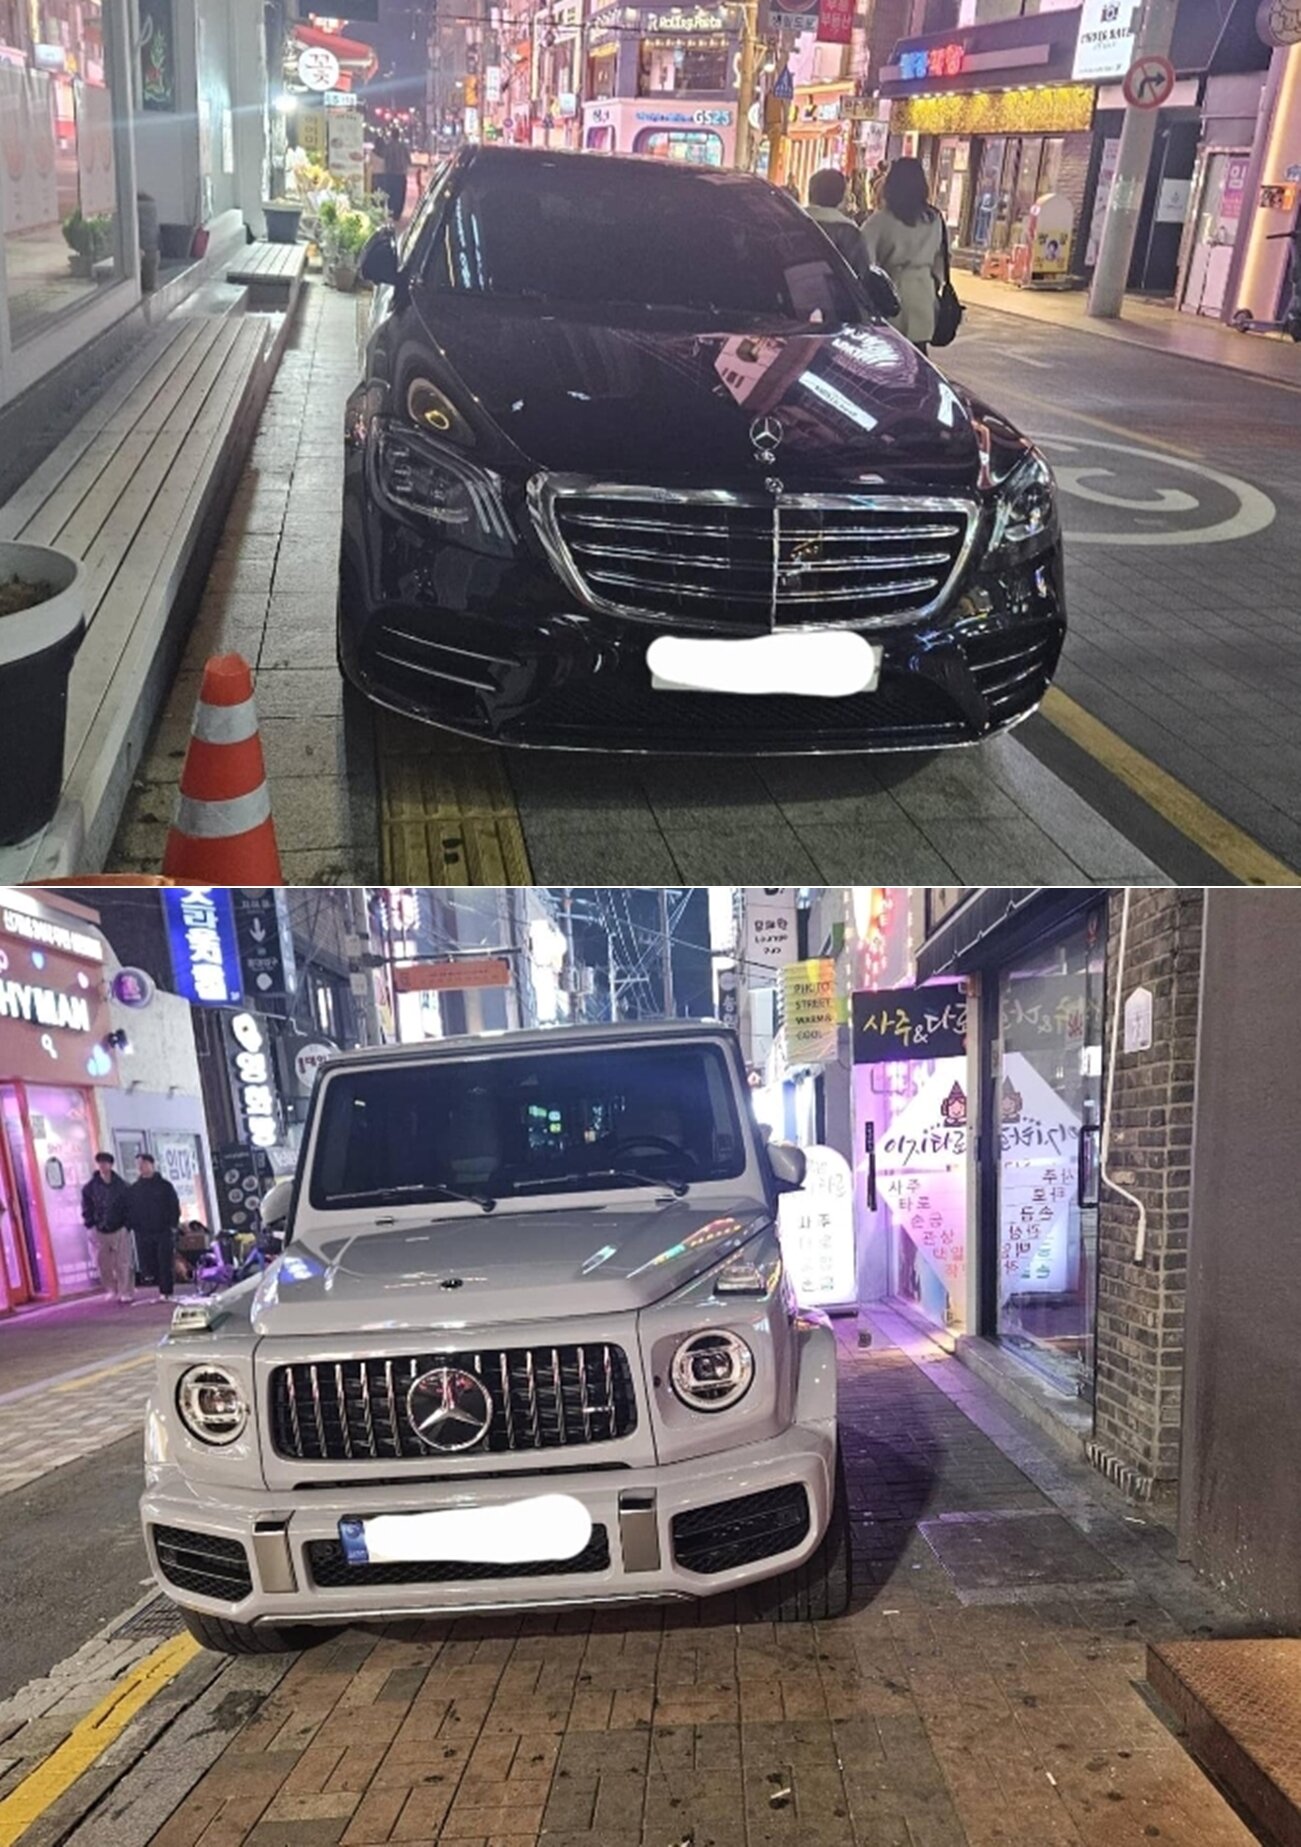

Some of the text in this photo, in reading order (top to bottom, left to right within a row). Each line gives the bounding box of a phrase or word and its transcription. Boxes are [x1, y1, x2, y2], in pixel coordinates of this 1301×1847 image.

[693, 109, 731, 126] GS25
[165, 1149, 192, 1181] 임대
[888, 1179, 921, 1195] 사주
[899, 1196, 931, 1212] 타로
[911, 1212, 943, 1229] 손금
[923, 1229, 954, 1246] 관상
